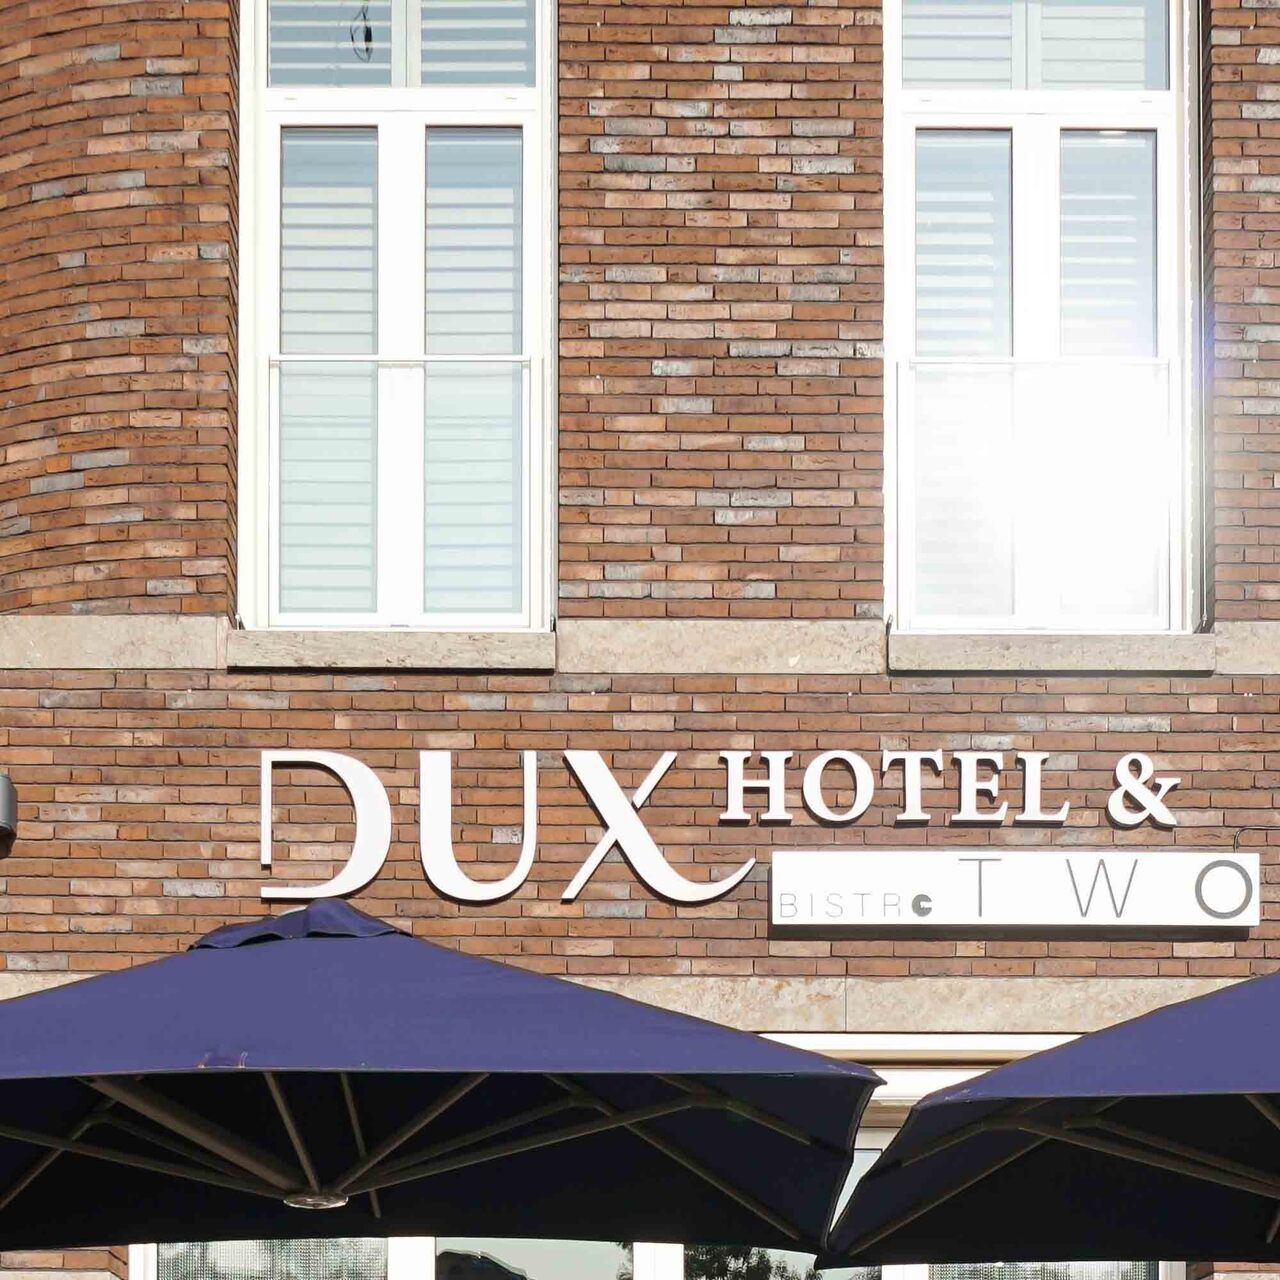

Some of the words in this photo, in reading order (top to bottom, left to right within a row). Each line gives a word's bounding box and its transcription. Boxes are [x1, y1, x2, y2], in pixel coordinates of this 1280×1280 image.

[260, 749, 756, 903] DUX
[719, 748, 1070, 823] HOTEL
[1106, 751, 1181, 827] &
